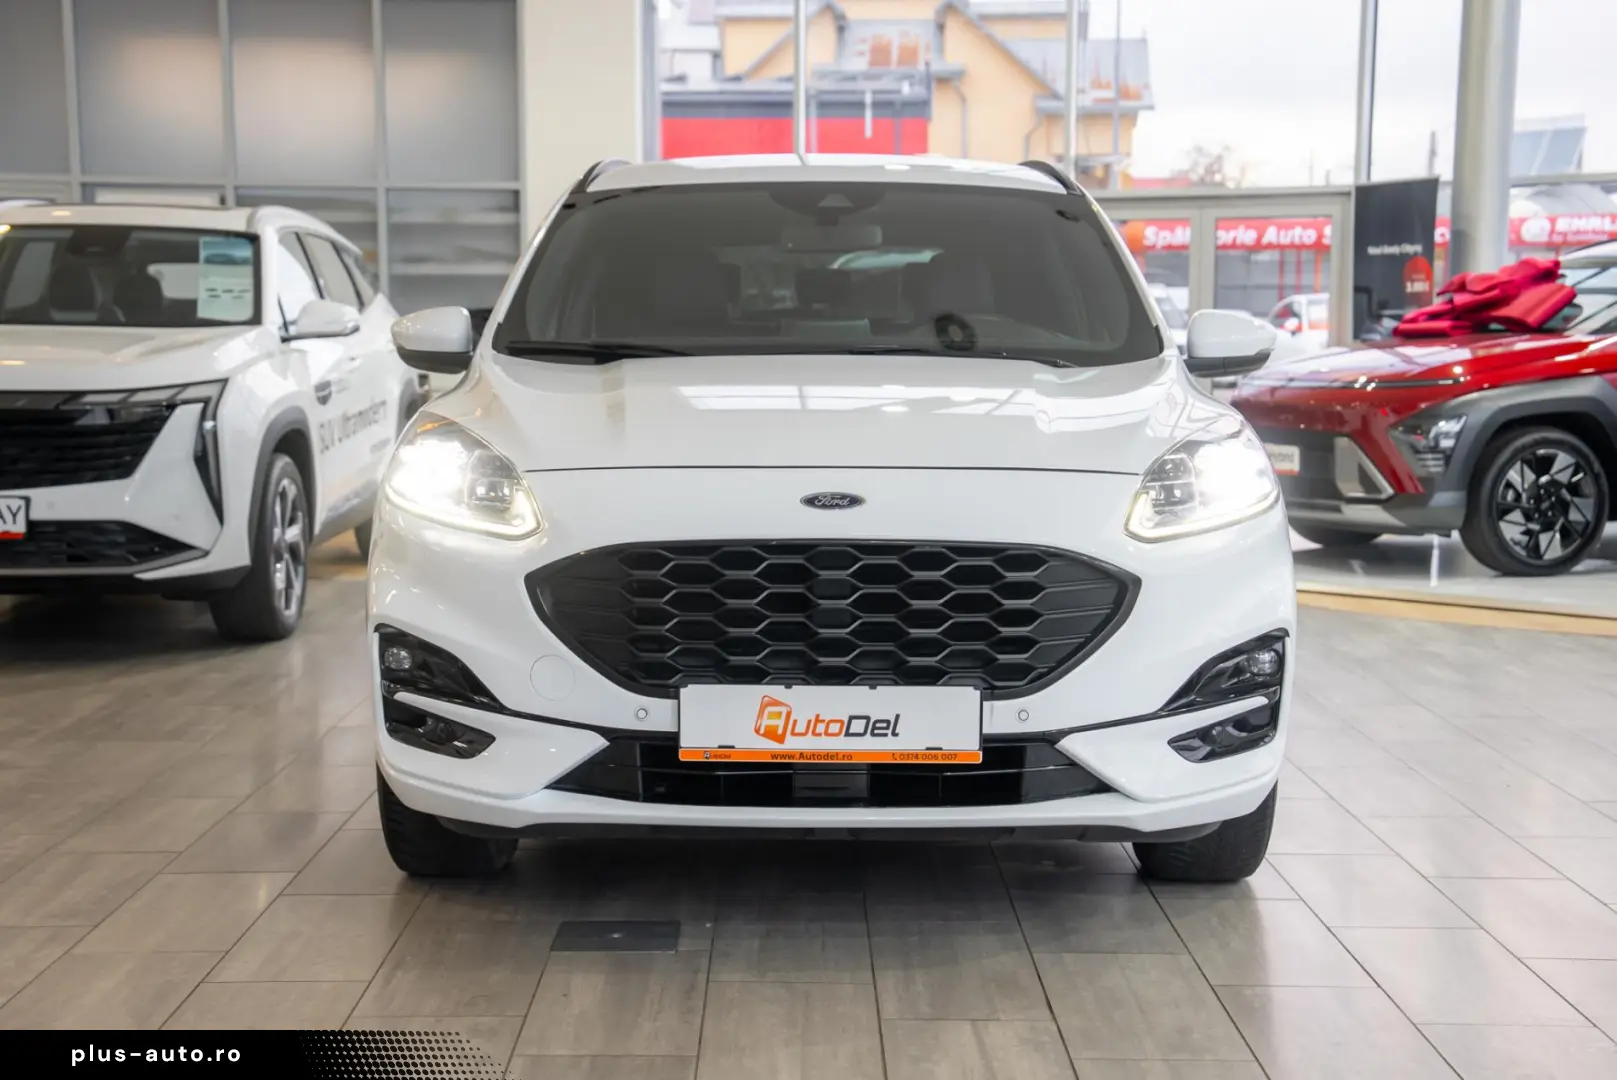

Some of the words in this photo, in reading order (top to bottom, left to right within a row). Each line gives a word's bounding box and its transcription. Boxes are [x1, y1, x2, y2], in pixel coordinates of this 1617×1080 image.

[1261, 224, 1317, 246] Auto
[814, 493, 851, 506] Ford
[755, 700, 901, 740] AutoDel
[770, 752, 853, 761] www.Autodel.ro
[899, 753, 920, 761] 0374
[941, 753, 958, 761] 007
